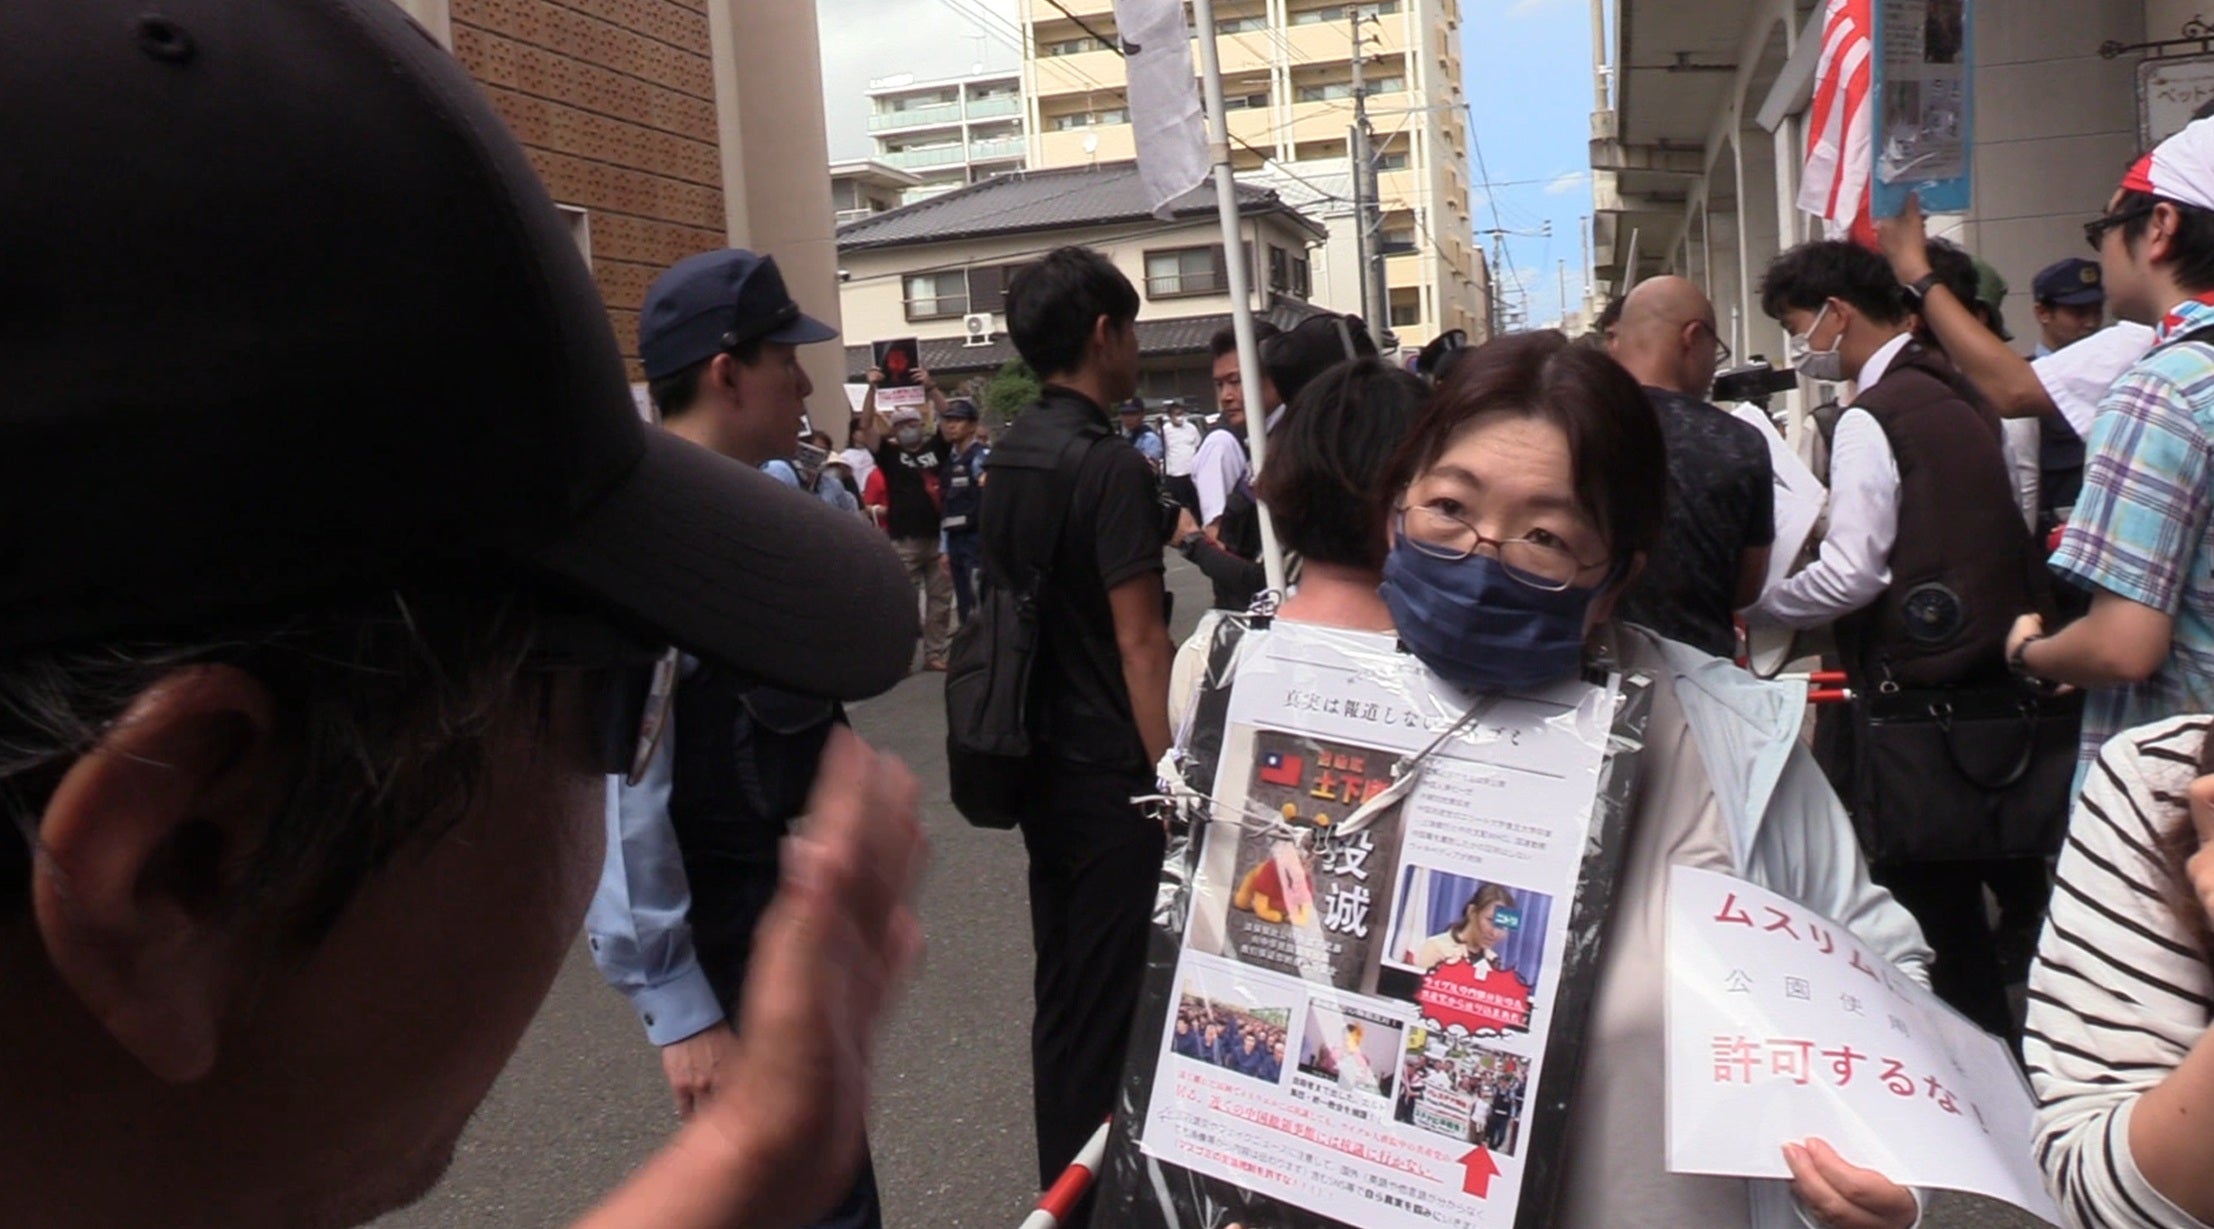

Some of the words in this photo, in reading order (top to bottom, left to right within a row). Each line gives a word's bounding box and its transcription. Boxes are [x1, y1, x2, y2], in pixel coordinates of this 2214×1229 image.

[1711, 1035, 1990, 1134] 許可するな！
